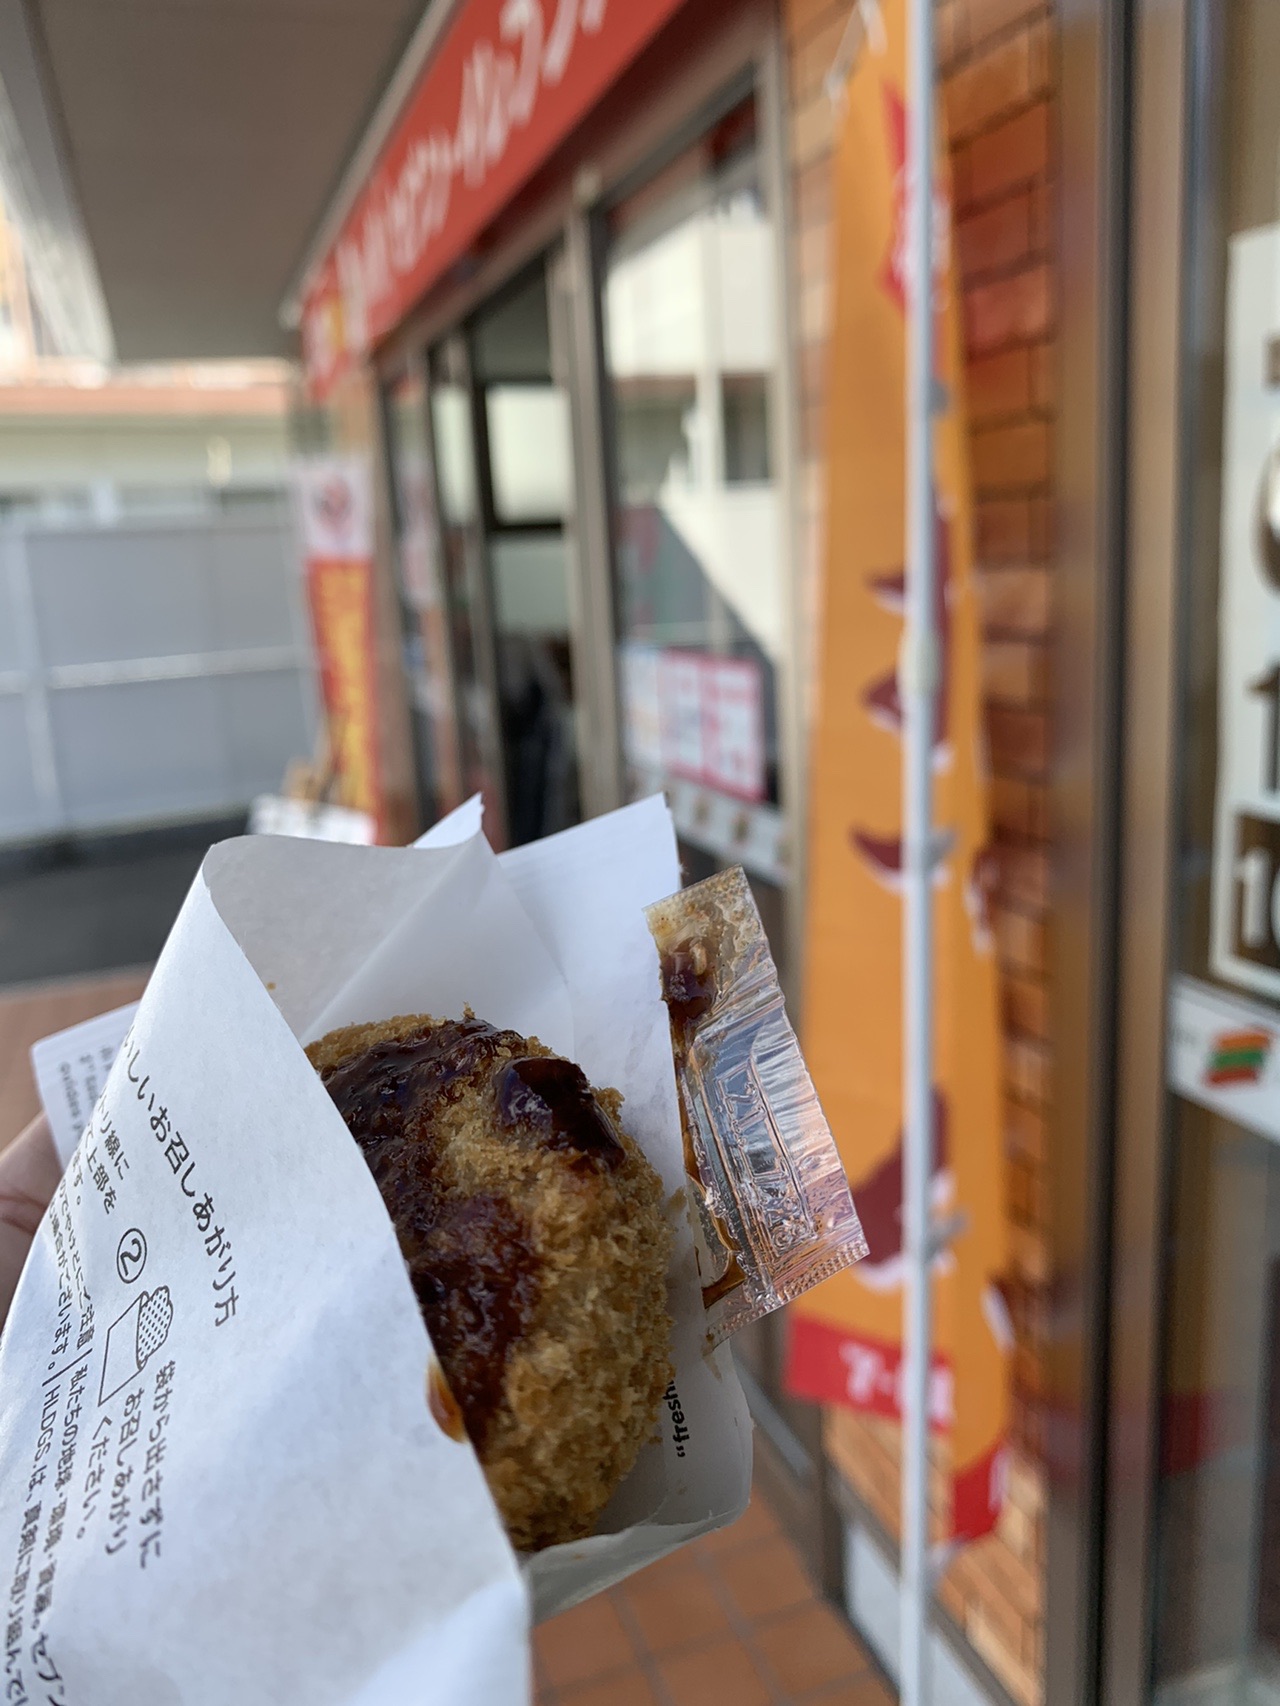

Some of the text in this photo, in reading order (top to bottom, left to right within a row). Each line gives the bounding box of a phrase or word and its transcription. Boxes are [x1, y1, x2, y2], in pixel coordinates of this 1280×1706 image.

[76, 1415, 113, 1540] ください。
[104, 1386, 145, 1556] お召しあがり
[139, 1359, 176, 1570] 袋から出さずに
